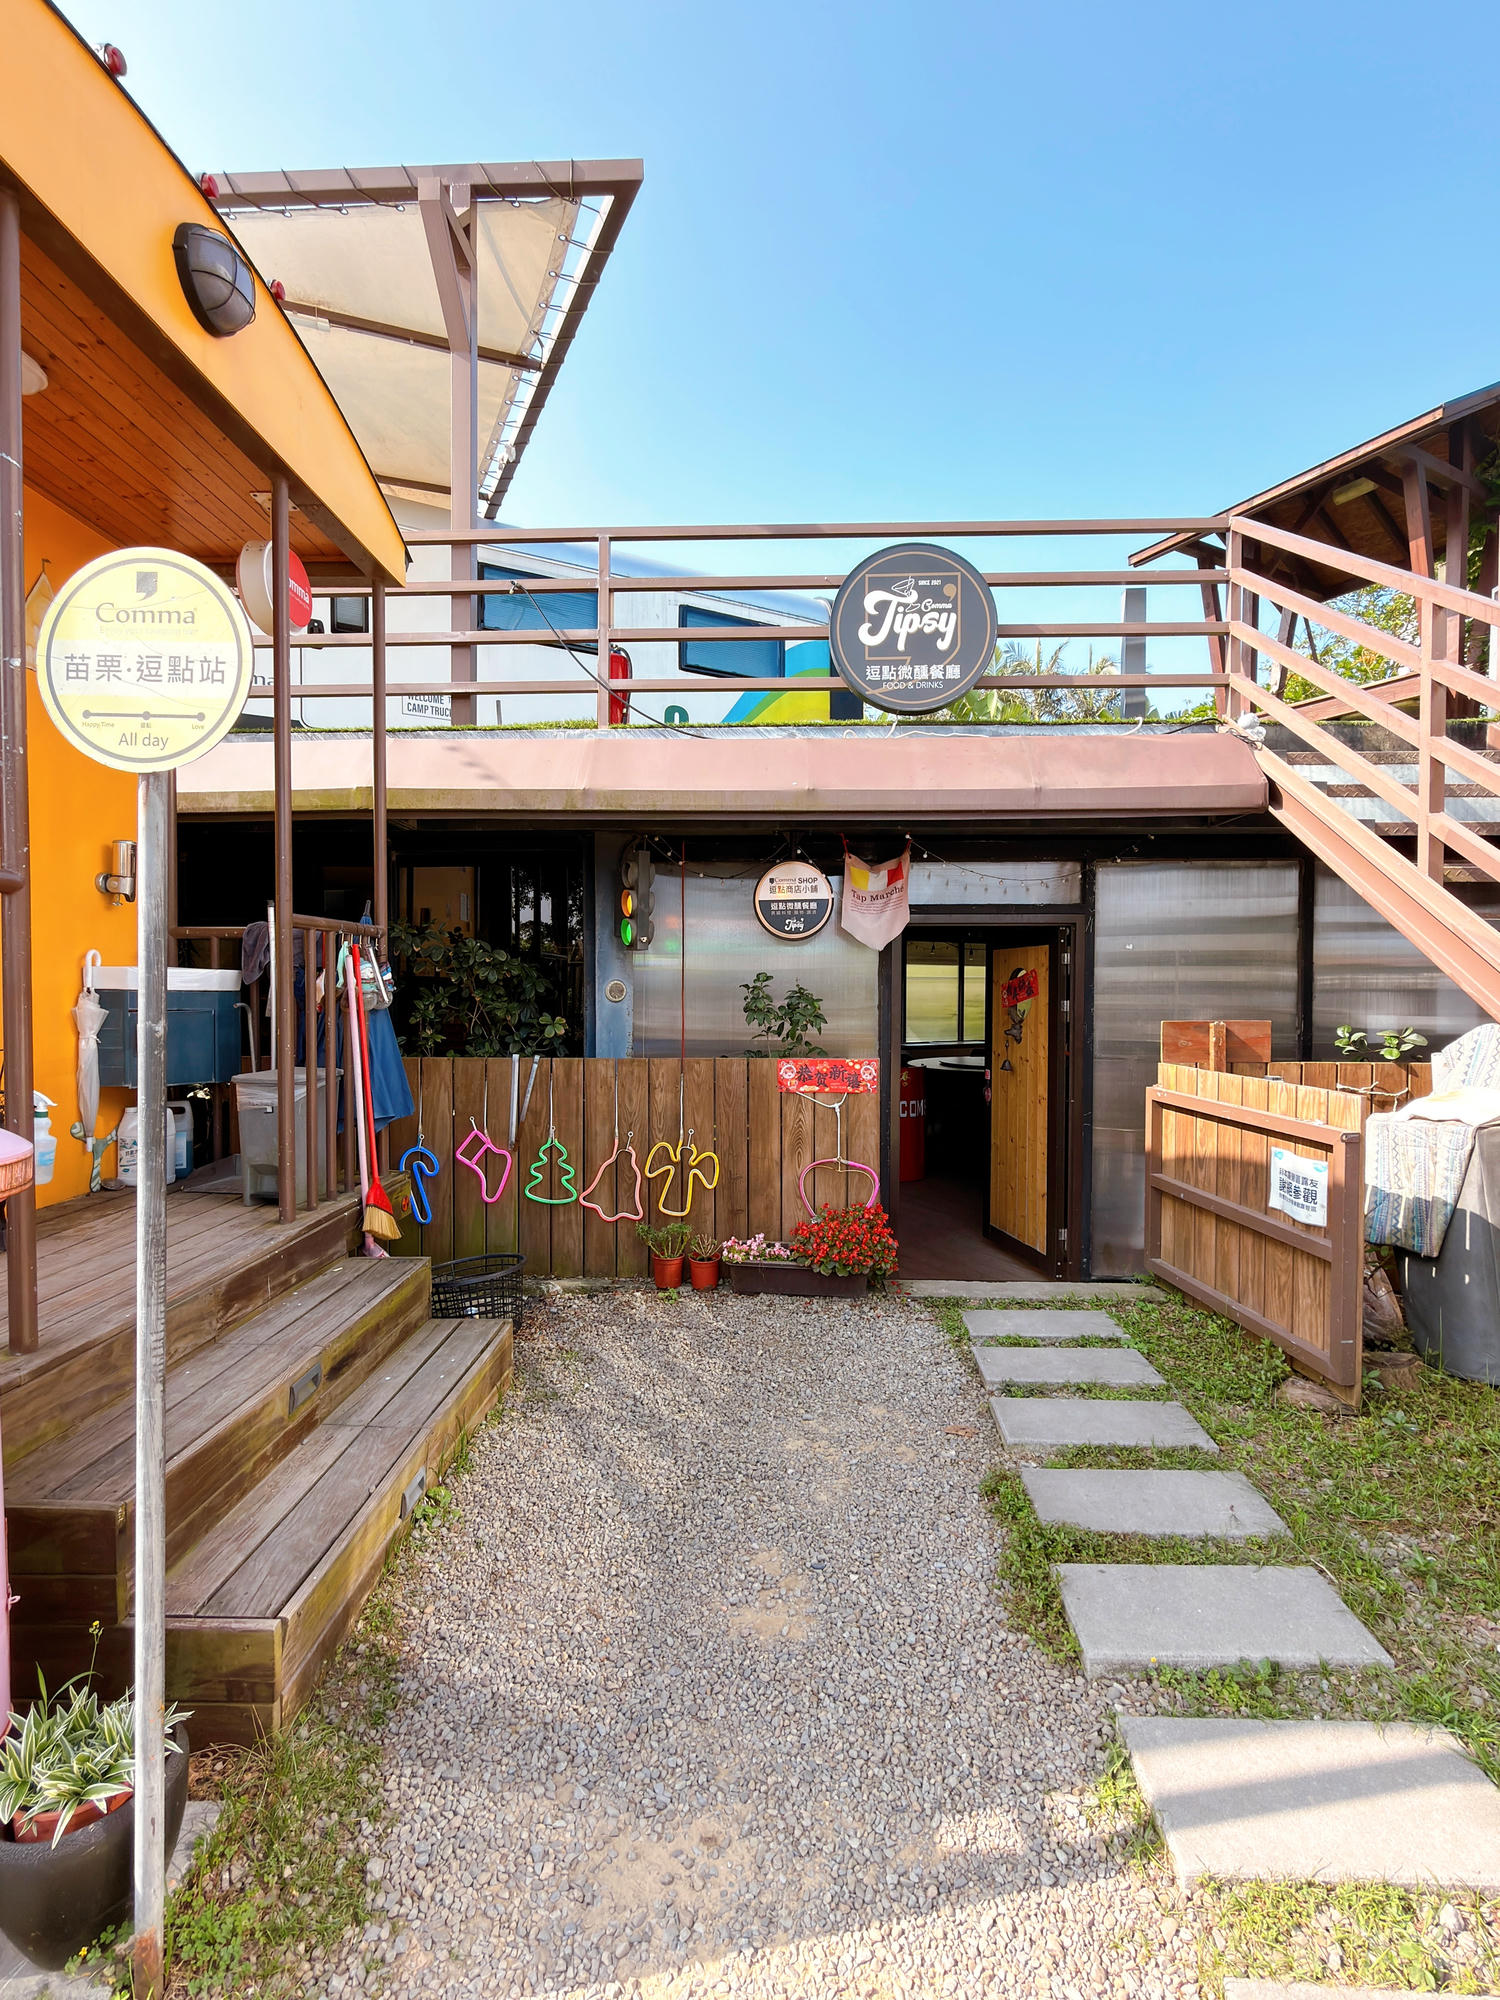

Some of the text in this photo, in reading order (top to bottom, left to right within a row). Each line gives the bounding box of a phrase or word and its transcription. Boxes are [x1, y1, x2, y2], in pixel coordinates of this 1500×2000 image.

[95, 602, 196, 624] Comma
[858, 589, 957, 652] Tipsy
[865, 664, 961, 680] 逗點微醺餐廳
[882, 680, 944, 690] FOOD & DRINKS
[407, 702, 452, 718] CAMP TRUC
[118, 732, 169, 751] All day
[851, 889, 867, 903] Tap
[796, 1063, 862, 1089] 恭賀新禧
